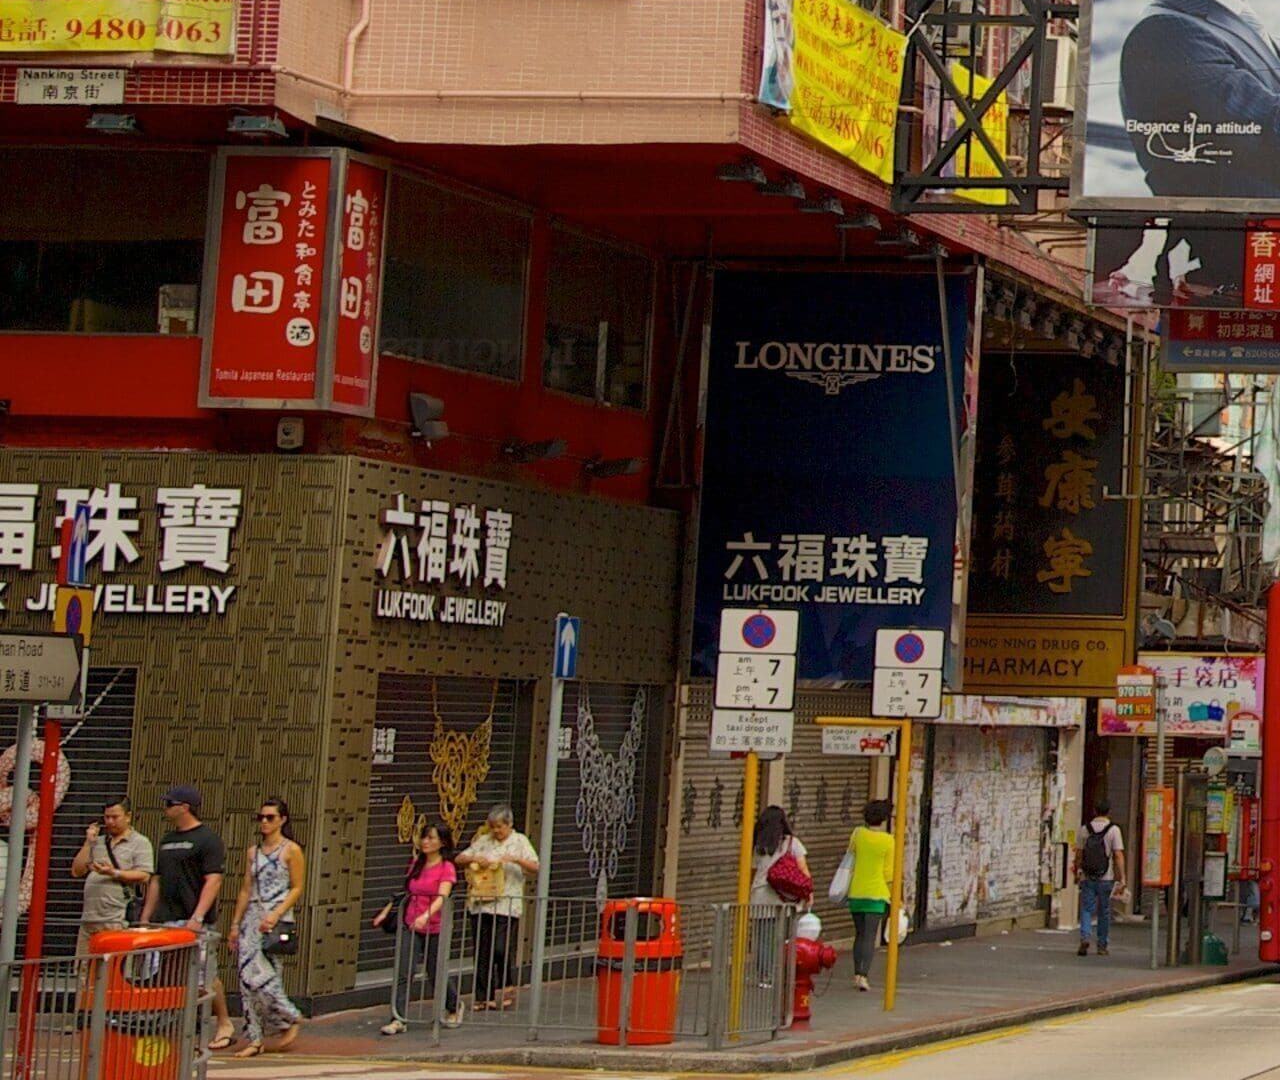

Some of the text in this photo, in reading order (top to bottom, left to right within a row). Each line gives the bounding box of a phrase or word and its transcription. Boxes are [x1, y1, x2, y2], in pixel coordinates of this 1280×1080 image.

[66, 18, 146, 42] 9480
[23, 69, 120, 83] Nanking Street
[42, 83, 101, 100] 南京街
[1126, 119, 1180, 135] Elegance
[1195, 123, 1212, 134] an
[1216, 121, 1262, 135] attitude
[231, 183, 291, 314] 富田
[1253, 263, 1275, 305] 網址
[735, 341, 935, 374] LONGINES
[376, 491, 513, 592] 六福珠寶
[724, 533, 929, 586] 六福珠寶
[723, 584, 926, 605] LUKFOOK JEWELLERY
[377, 588, 507, 627] LUKFOOK JEWELLERY
[18, 640, 43, 657] Road
[1003, 638, 1036, 650] NING
[1042, 639, 1080, 650] DRUG
[1086, 640, 1109, 651] CO.
[738, 656, 781, 676] am 7
[918, 673, 929, 688] 7
[735, 685, 779, 704] pm 7
[917, 699, 928, 714] 7
[726, 724, 779, 734] taxi drop off
[738, 715, 768, 725] Except
